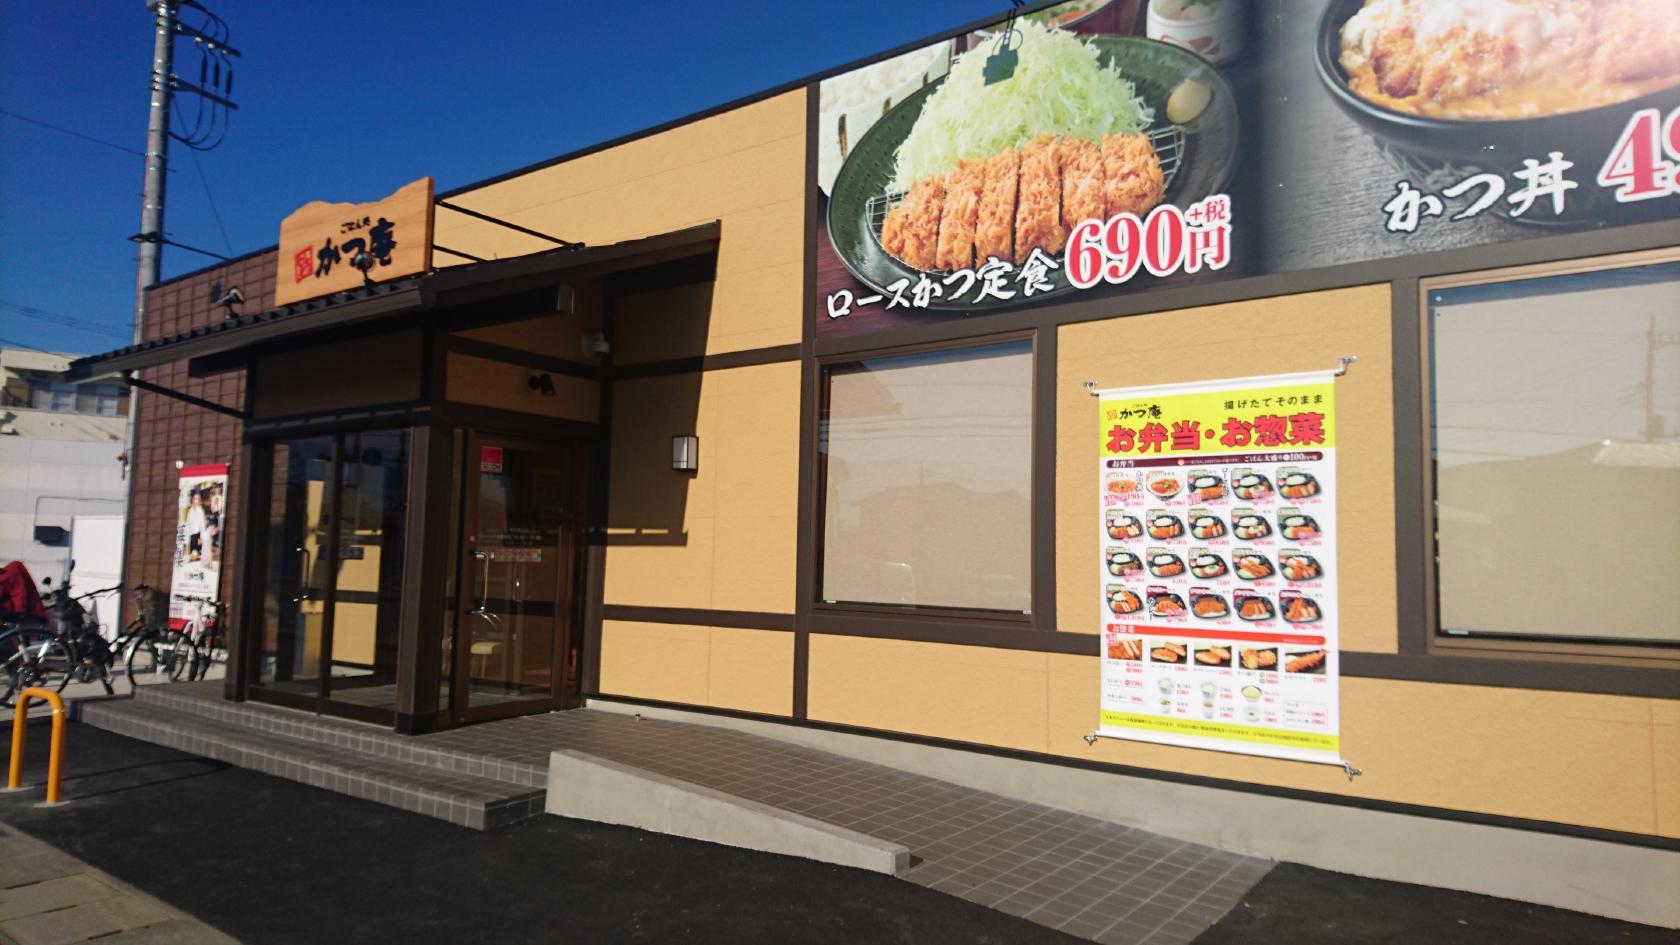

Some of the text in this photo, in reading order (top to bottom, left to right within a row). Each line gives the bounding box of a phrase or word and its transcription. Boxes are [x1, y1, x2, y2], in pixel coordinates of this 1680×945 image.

[1384, 151, 1578, 232] かつ丼
[1599, 110, 1680, 202] 4
[827, 247, 1061, 319] ロースかつ定食
[1106, 412, 1325, 453] お弁当・お惣菜
[1224, 394, 1323, 411] 揚げたてそのまま
